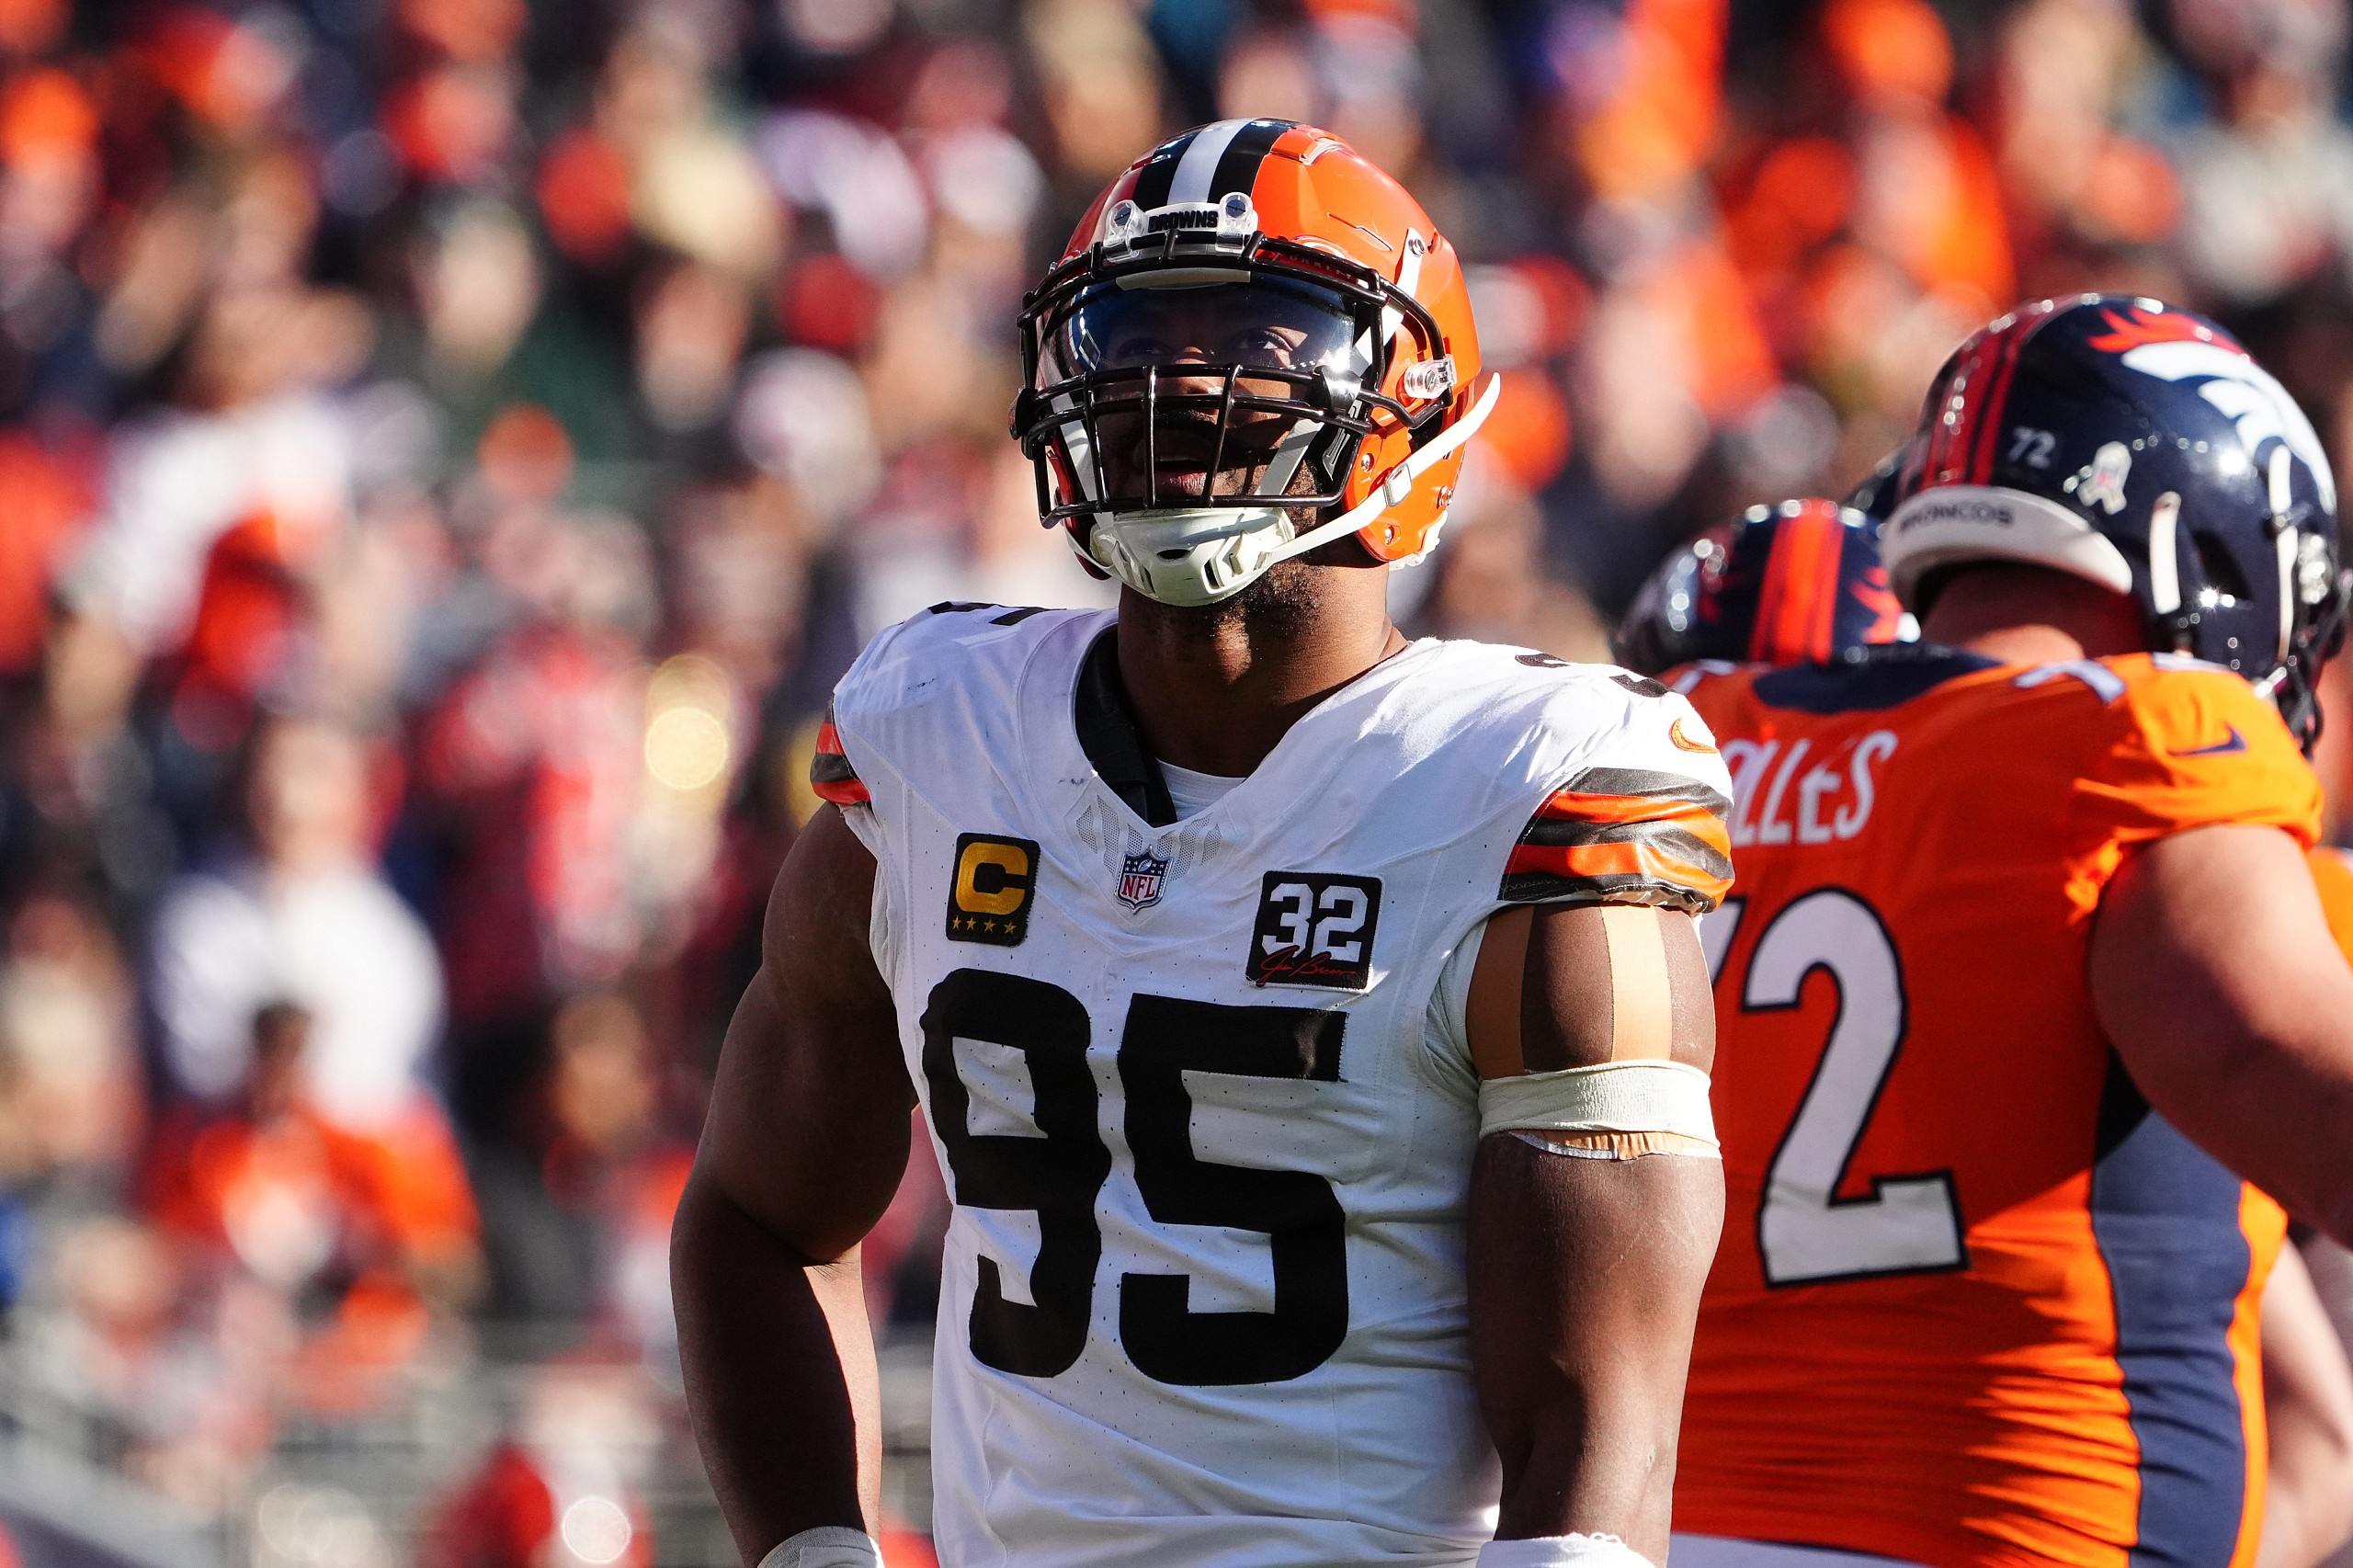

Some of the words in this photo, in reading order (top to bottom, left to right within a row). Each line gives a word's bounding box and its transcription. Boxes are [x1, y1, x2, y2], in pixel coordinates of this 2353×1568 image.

[1148, 210, 1219, 233] BROWNS
[2008, 426, 2057, 469] 72
[1899, 501, 2014, 532] BRONCOS
[956, 842, 1029, 915] C
[1121, 874, 1155, 901] NFL
[1261, 882, 1369, 963] 32
[919, 968, 1349, 1386] 95
